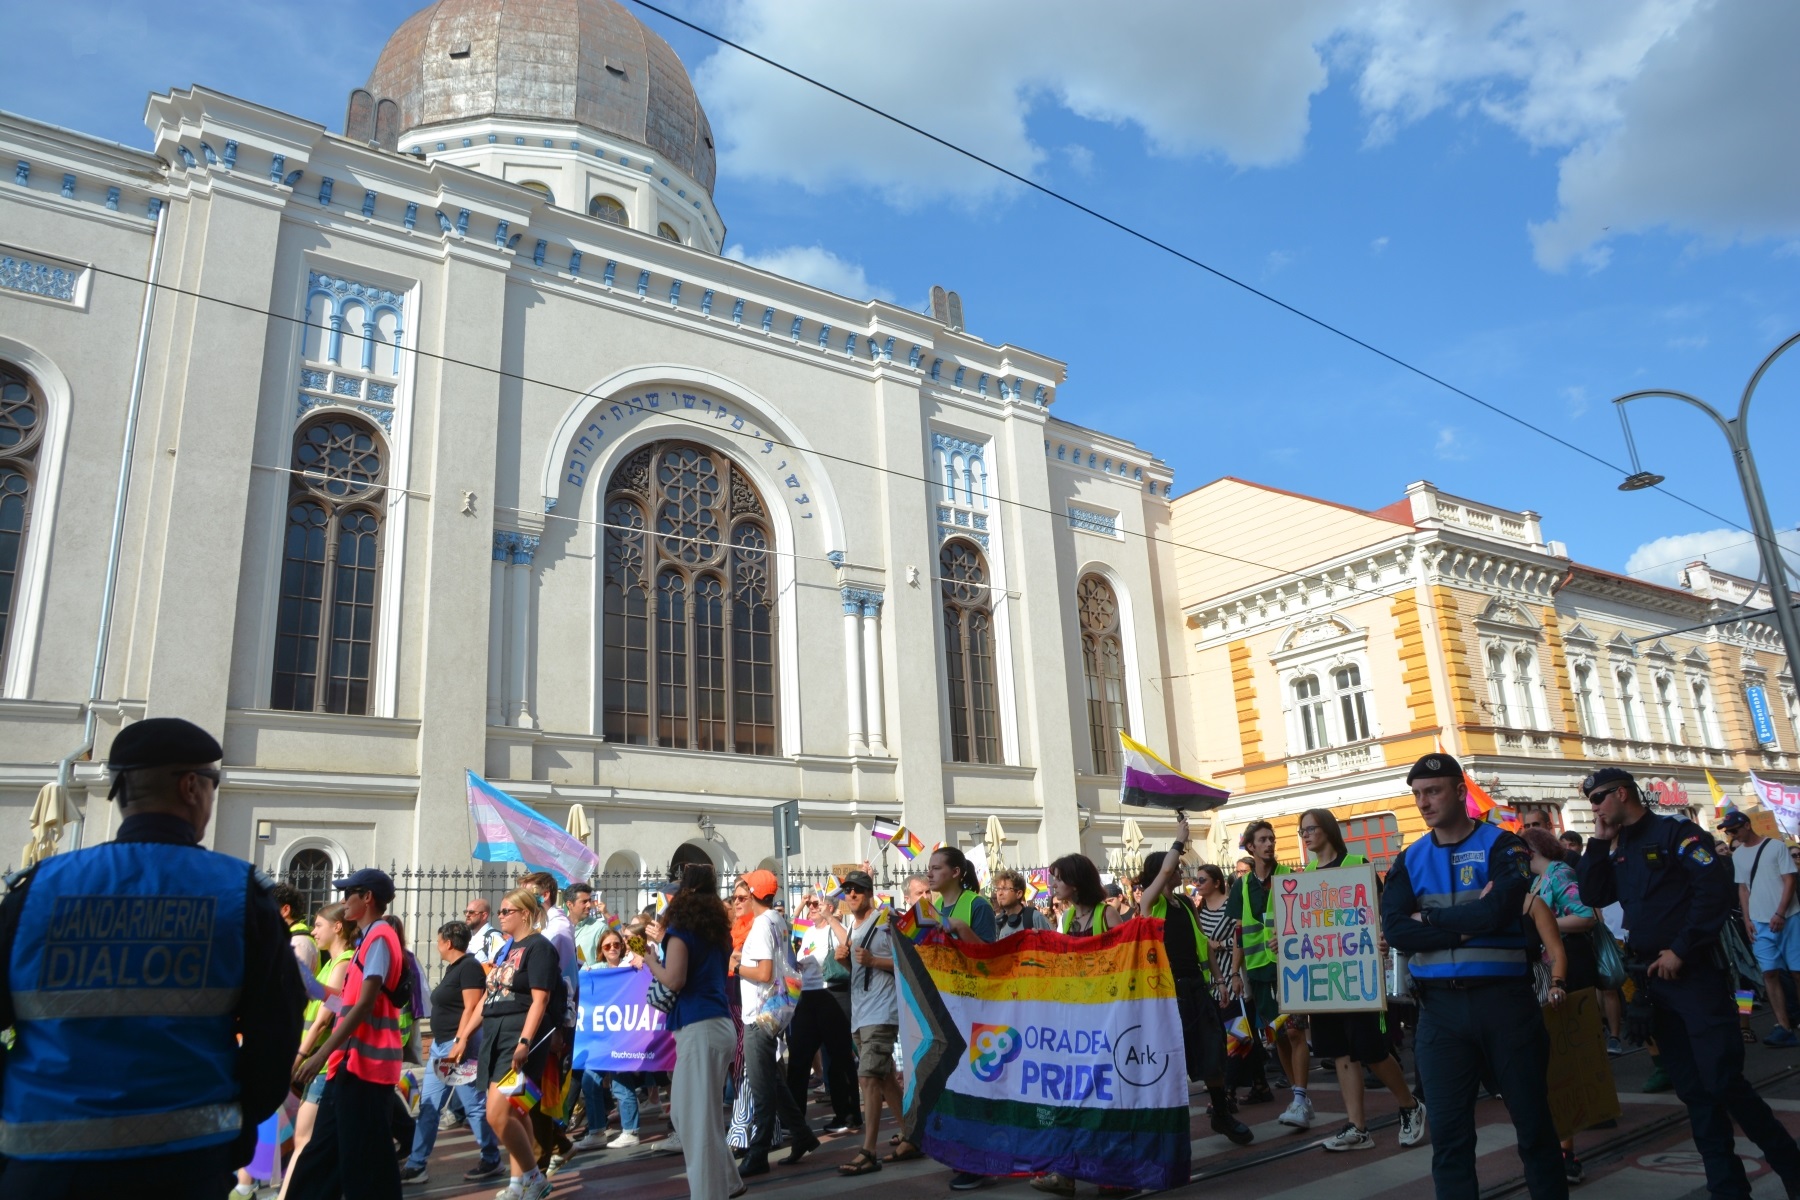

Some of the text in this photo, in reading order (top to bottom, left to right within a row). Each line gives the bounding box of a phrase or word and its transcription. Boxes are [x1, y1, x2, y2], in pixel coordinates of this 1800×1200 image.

[53, 899, 209, 939] JANDARMERIA
[47, 945, 201, 987] DIALOG
[1283, 960, 1377, 1003] MEREU
[592, 1004, 667, 1031] EQUAL
[1025, 1025, 1112, 1055] ORADEA
[1125, 1044, 1157, 1066] Ark
[1021, 1060, 1114, 1101] PRIDE
